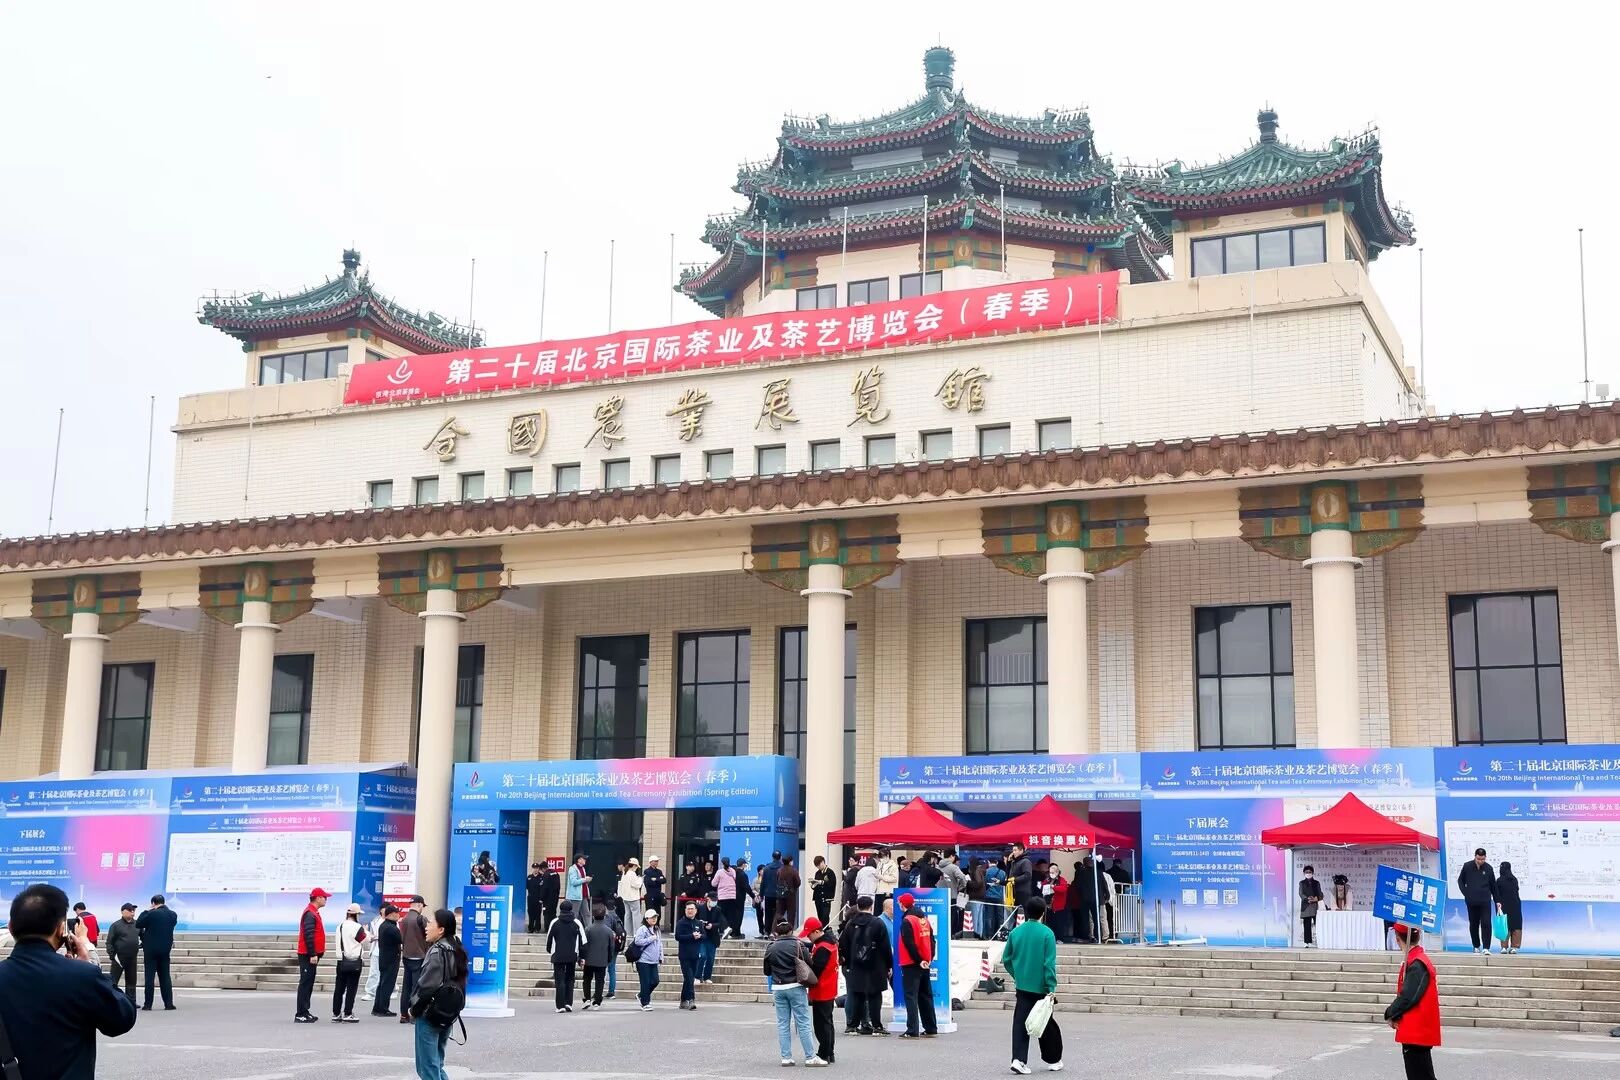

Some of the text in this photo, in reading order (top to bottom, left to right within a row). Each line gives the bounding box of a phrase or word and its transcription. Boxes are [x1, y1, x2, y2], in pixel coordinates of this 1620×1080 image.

[446, 286, 1073, 385] 第二十届北京国际茶业及茶艺博览会（春季）
[924, 764, 1112, 777] 第二十届北京国际茶业及茶艺博览会（春季）
[1191, 764, 1400, 777] 第二十届北京国际茶业及茶艺博览会（春季）
[503, 769, 737, 788] 第二十届北京国际茶业及茶艺博览会（春季）
[204, 784, 334, 794] 第二十届北京国际茶业及茶艺博览会（春季）
[632, 790, 666, 798] Ceremony
[704, 789, 728, 797] (Spring
[1186, 817, 1229, 829] 下届展会
[1029, 834, 1088, 846] 抖音换票处
[548, 860, 564, 870] 出口
